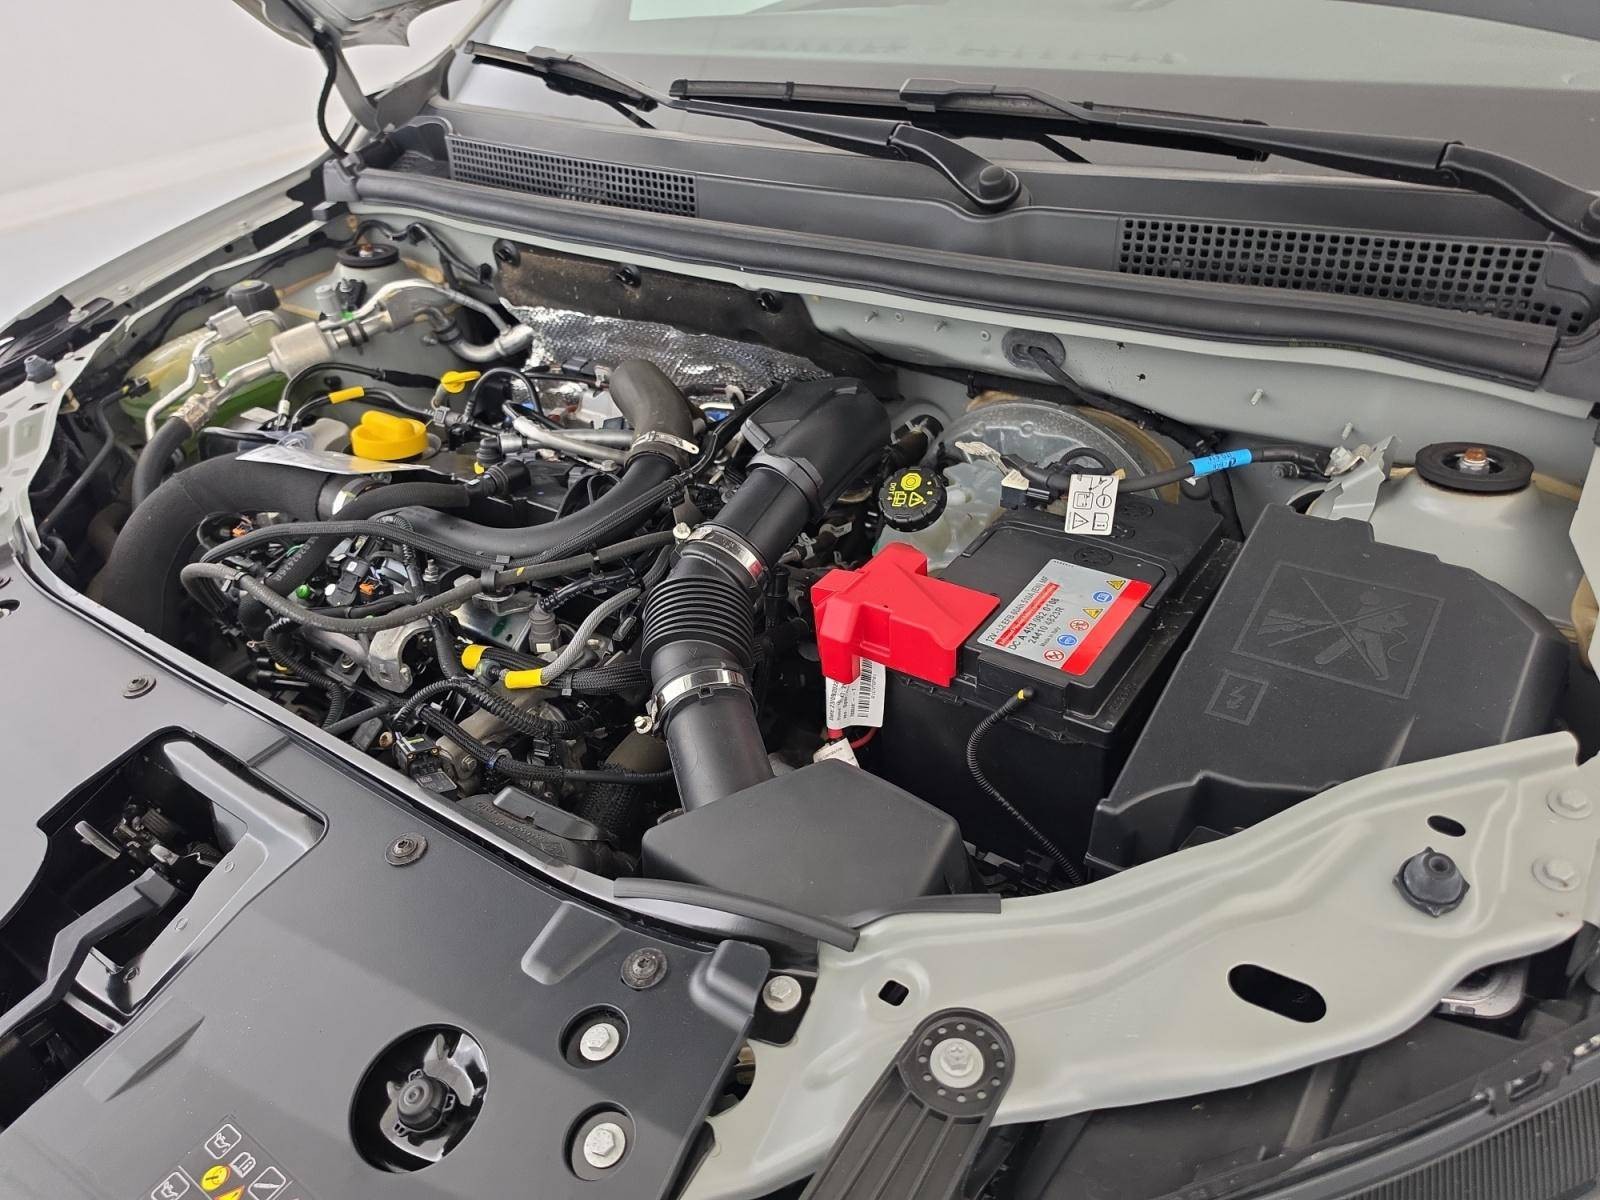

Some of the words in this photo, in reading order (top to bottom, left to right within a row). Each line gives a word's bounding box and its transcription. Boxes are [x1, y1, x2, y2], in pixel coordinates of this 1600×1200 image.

[888, 482, 897, 495] DOT
[986, 632, 998, 643] 12V
[1003, 613, 1015, 625] EFB
[1008, 640, 1021, 650] DC
[1024, 622, 1037, 633] 453
